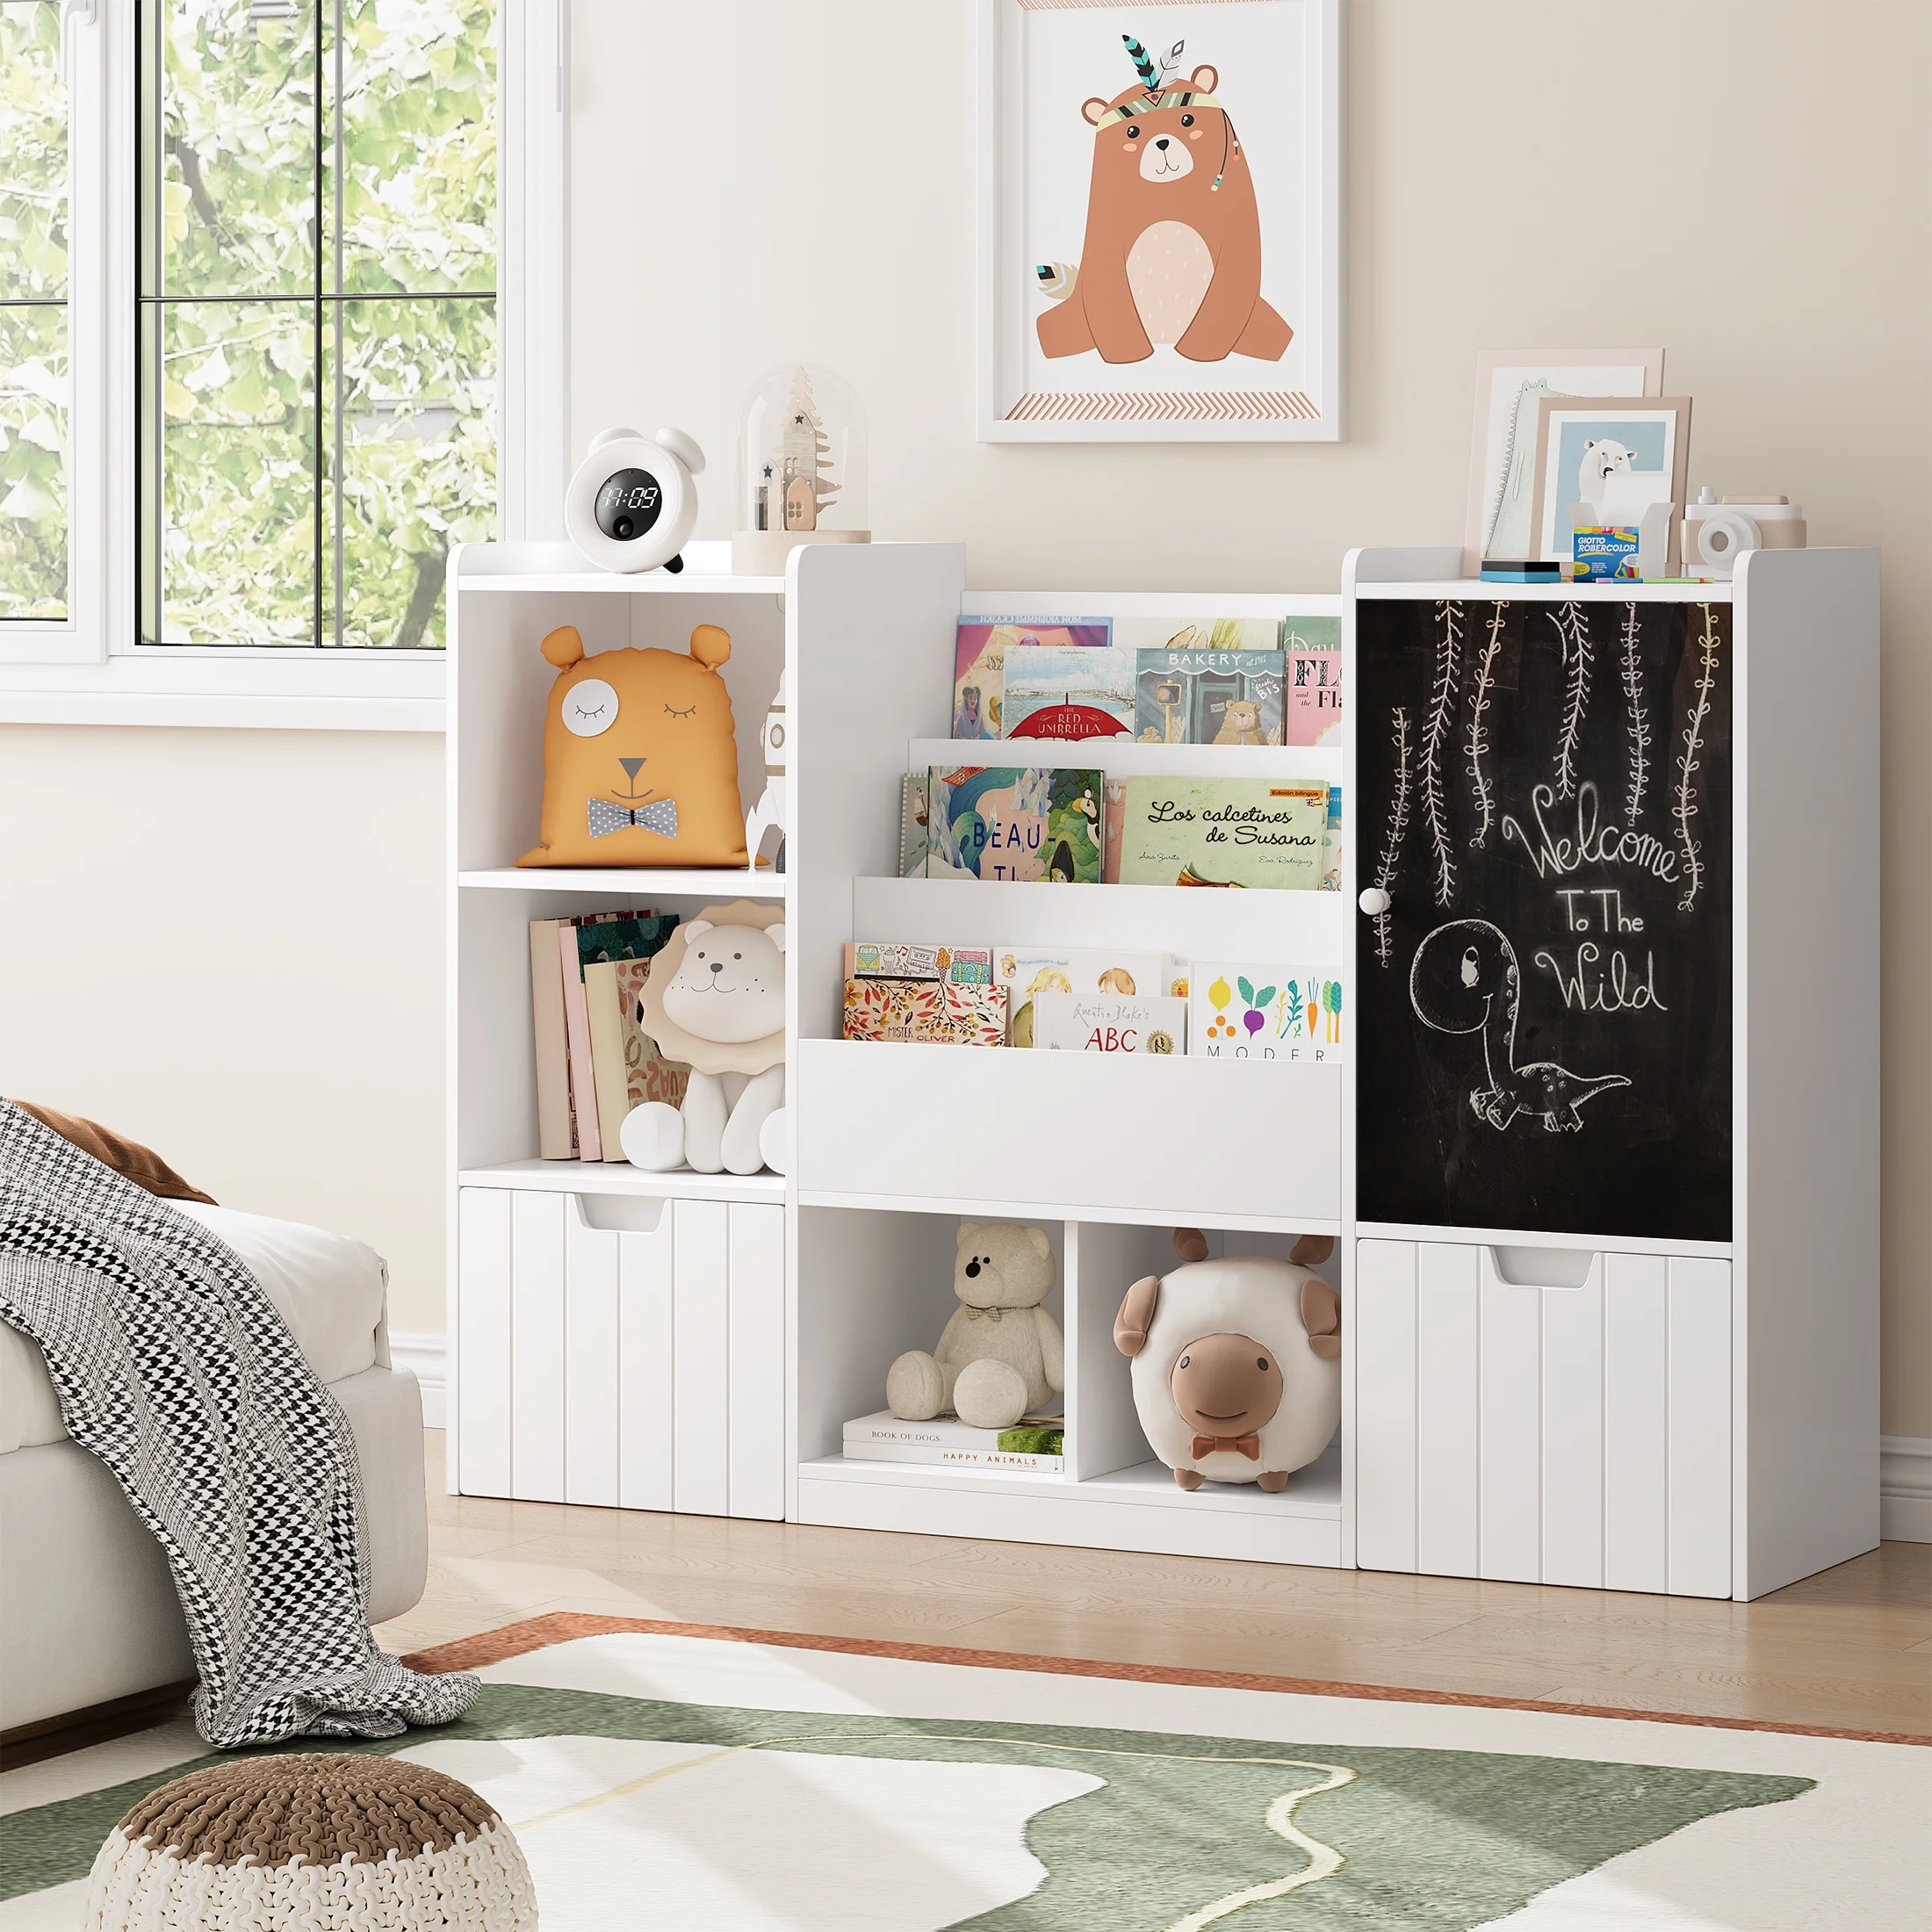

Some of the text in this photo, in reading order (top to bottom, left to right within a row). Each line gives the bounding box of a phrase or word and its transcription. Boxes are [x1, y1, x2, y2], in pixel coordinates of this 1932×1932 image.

[604, 487, 659, 508] 11:09
[1169, 653, 1242, 666] BAKERY
[1293, 660, 1342, 687] FL
[1058, 713, 1081, 724] RED
[1038, 724, 1102, 735] UMBRELLA
[1147, 800, 1293, 824] Los calcetines
[1206, 825, 1316, 846] de Susana
[1502, 781, 1680, 883] Welcome
[1258, 855, 1276, 864] Eva
[1555, 889, 1645, 933] To The
[1534, 941, 1669, 1012] Wild
[1072, 1002, 1150, 1028] Quentin Blake's
[887, 1026, 914, 1039] MISTER
[916, 1034, 955, 1043] OLIVER
[1084, 1027, 1138, 1052] ABC
[871, 1431, 897, 1439] BOOK
[915, 1433, 941, 1443] DOGS
[942, 1452, 1037, 1466] HAPPY ANIMALS
